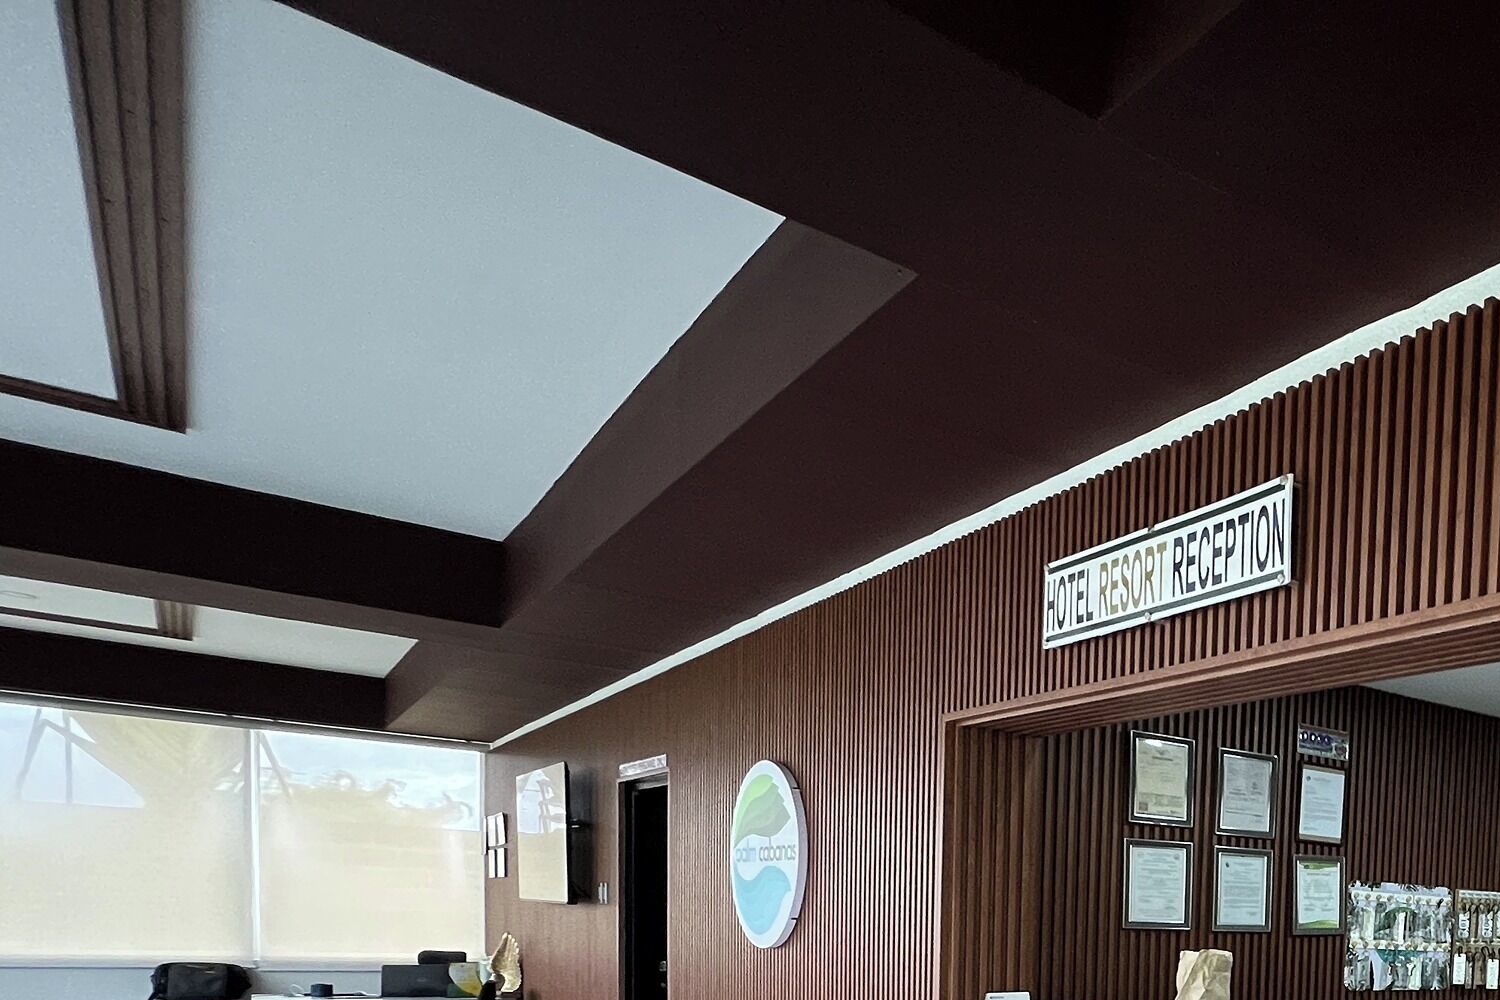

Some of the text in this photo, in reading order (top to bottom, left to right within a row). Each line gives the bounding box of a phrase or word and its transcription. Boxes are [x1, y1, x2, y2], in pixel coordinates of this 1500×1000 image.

[1046, 498, 1286, 633] HOTEL RESORT RECEPTION
[758, 838, 797, 863] cabanas
